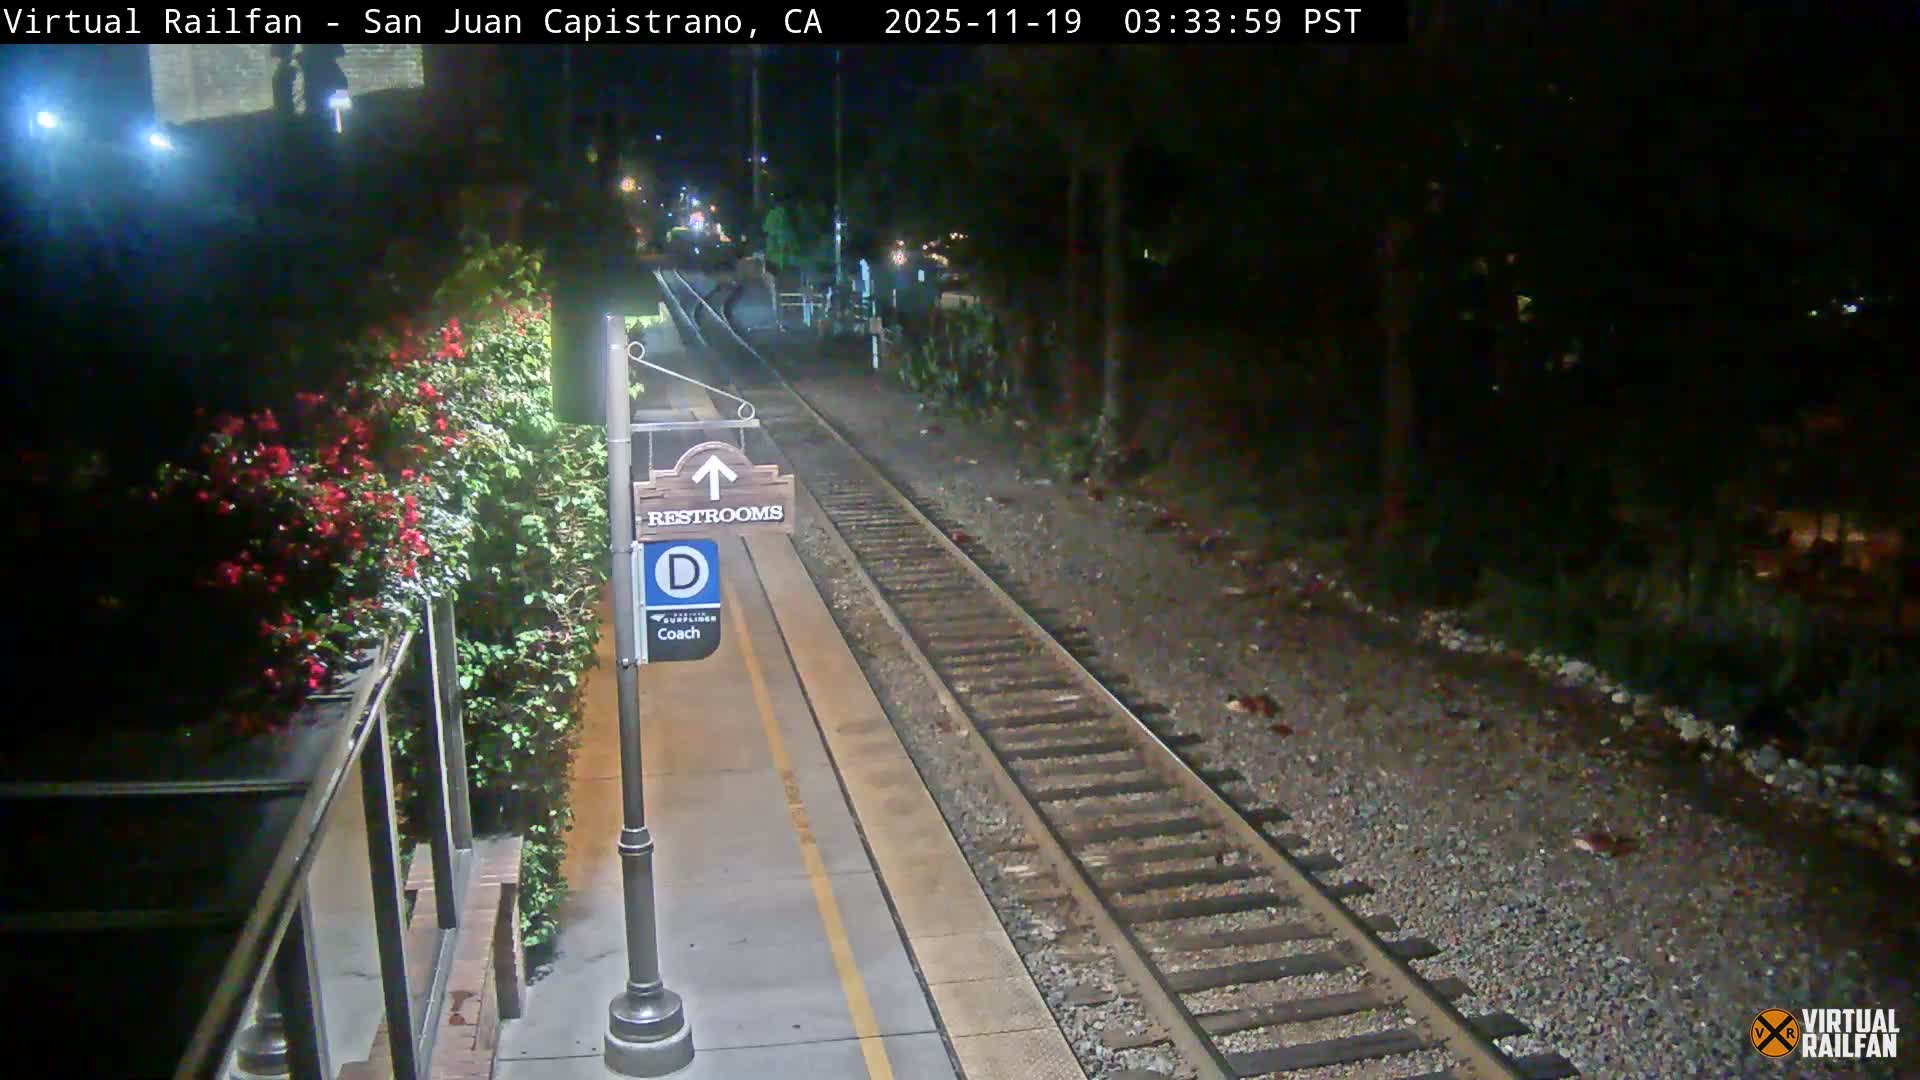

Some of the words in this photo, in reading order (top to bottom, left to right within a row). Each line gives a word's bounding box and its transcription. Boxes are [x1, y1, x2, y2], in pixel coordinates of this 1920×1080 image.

[647, 504, 784, 527] RESTROOMS
[668, 553, 700, 590] D
[657, 626, 701, 641] Coach
